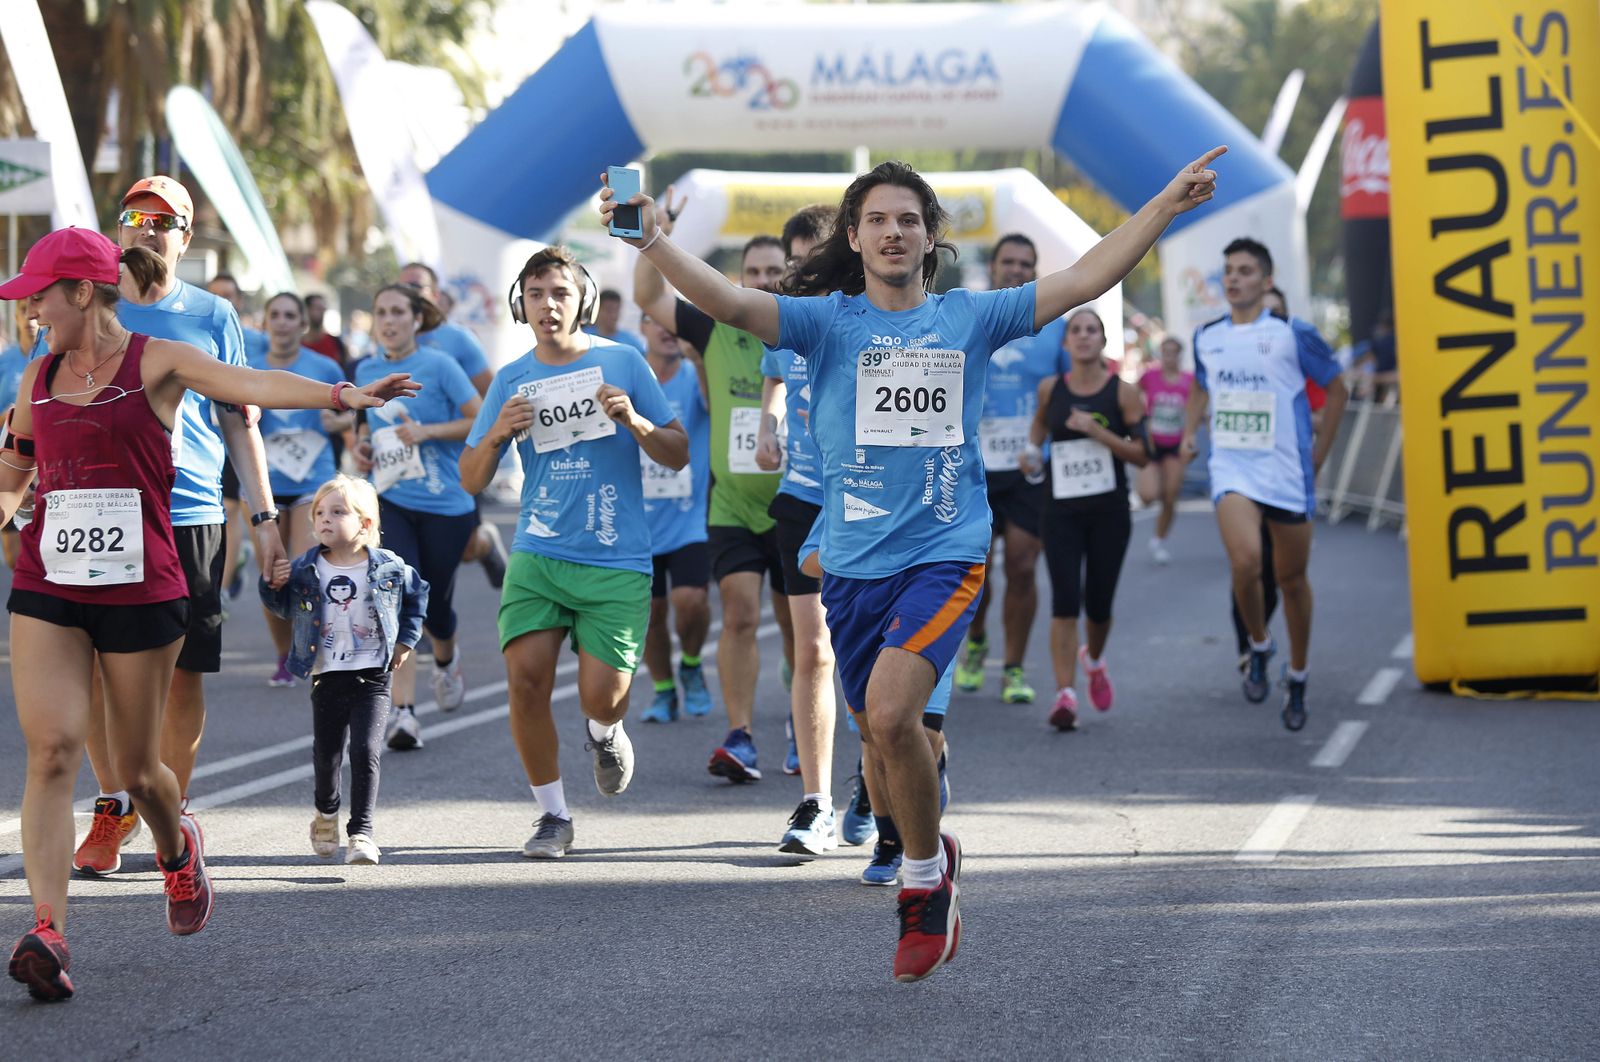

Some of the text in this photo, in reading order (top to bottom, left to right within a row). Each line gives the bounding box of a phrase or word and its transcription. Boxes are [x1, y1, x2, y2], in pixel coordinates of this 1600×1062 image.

[810, 47, 1000, 87] MÁLAGA
[1419, 18, 1529, 581] RENAULT
[1513, 10, 1598, 573] RUNNERS.ES
[933, 360, 962, 368] MÁLAGA
[546, 370, 597, 386] CARRERA URBANA
[539, 398, 597, 427] 6042
[874, 386, 947, 413] 2606
[1216, 413, 1267, 432] 21851
[551, 456, 590, 471] Unicaja
[858, 479, 884, 487] MÁLAGA
[922, 457, 935, 505] Renault
[586, 493, 596, 531] Renault
[56, 526, 124, 553] 9282
